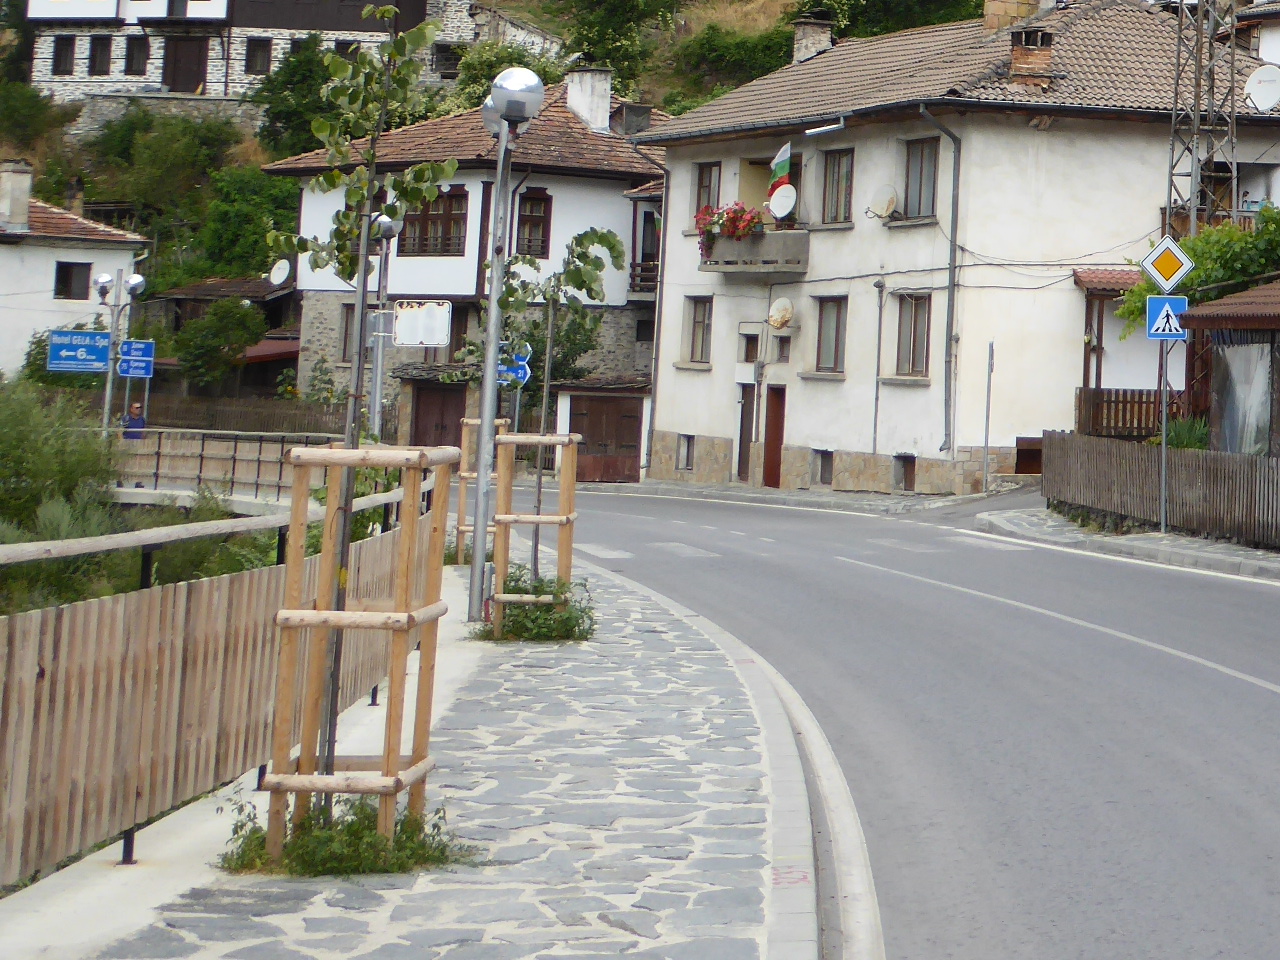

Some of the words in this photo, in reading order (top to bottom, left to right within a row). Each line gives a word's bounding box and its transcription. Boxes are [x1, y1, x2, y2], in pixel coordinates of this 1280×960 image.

[72, 335, 90, 345] GELA
[95, 335, 109, 348] Spa
[76, 348, 86, 360] 6
